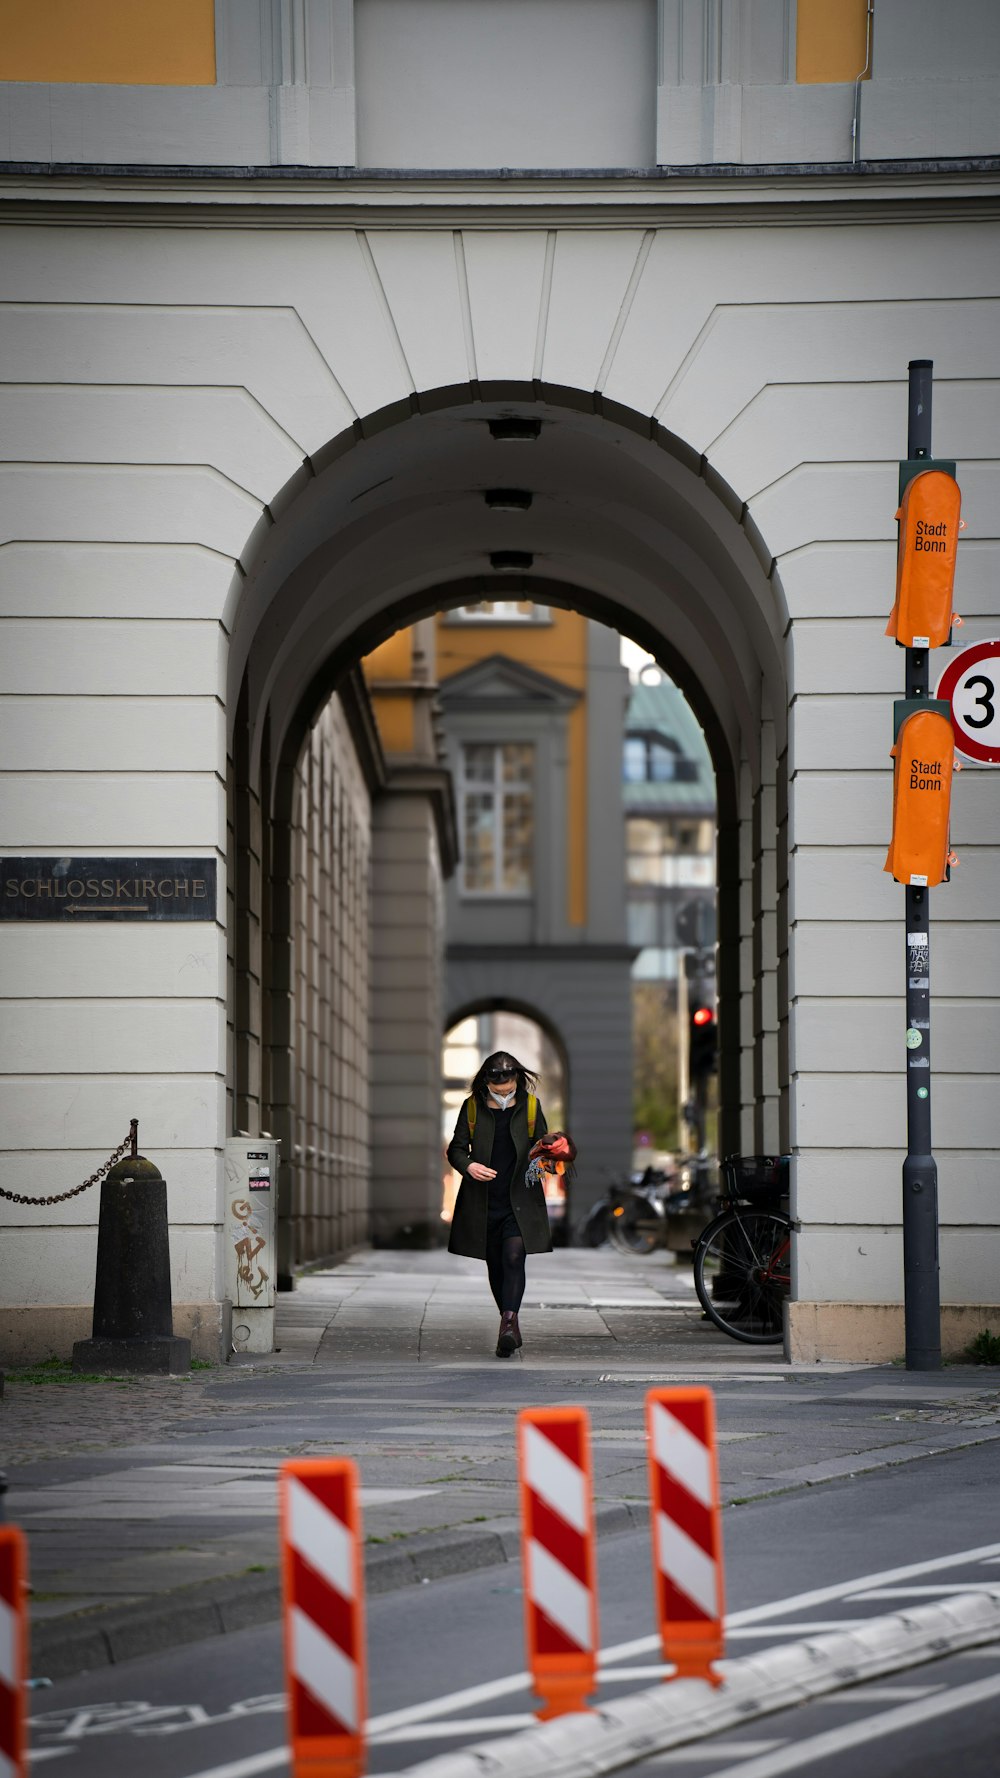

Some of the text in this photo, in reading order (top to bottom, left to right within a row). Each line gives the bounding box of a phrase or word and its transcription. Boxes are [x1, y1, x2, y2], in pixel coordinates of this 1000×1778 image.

[916, 520, 947, 536] Stadt
[915, 536, 946, 552] Bonn
[963, 675, 995, 729] 3
[911, 759, 942, 775] Stadt
[910, 774, 941, 791] Bonn
[6, 879, 206, 898] SCHLOSSKIRCHE
